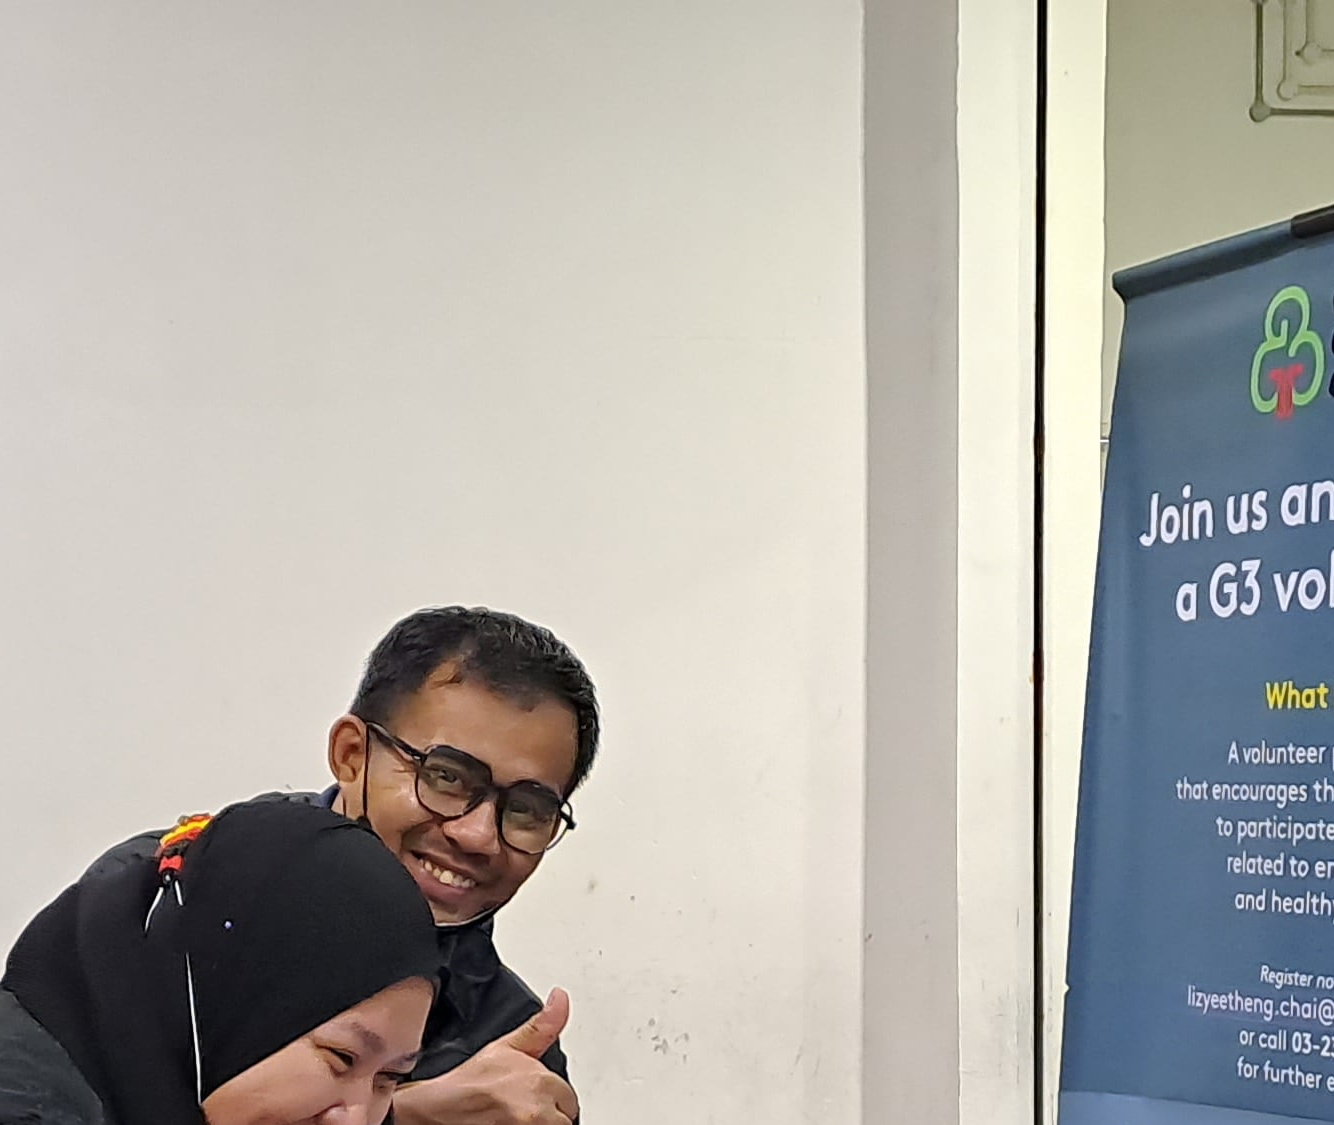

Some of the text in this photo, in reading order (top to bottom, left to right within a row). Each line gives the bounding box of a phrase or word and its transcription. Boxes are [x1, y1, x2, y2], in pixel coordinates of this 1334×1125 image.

[1139, 484, 1214, 548] Join
[1226, 489, 1268, 532] us
[1175, 582, 1198, 621] a
[1209, 559, 1261, 618] G3
[1265, 680, 1328, 710] What
[1227, 741, 1241, 765] A
[1242, 740, 1327, 766] volunteer
[1175, 777, 1209, 801] that
[1211, 782, 1308, 808] encourages
[1216, 815, 1233, 837] to
[1226, 851, 1284, 877] related
[1289, 854, 1309, 878] to
[1234, 888, 1266, 912] and
[1260, 965, 1313, 990] Register
[1238, 1028, 1255, 1047] or
[1258, 1028, 1288, 1051] call
[1236, 1055, 1260, 1079] for
[1263, 1060, 1322, 1089] further
